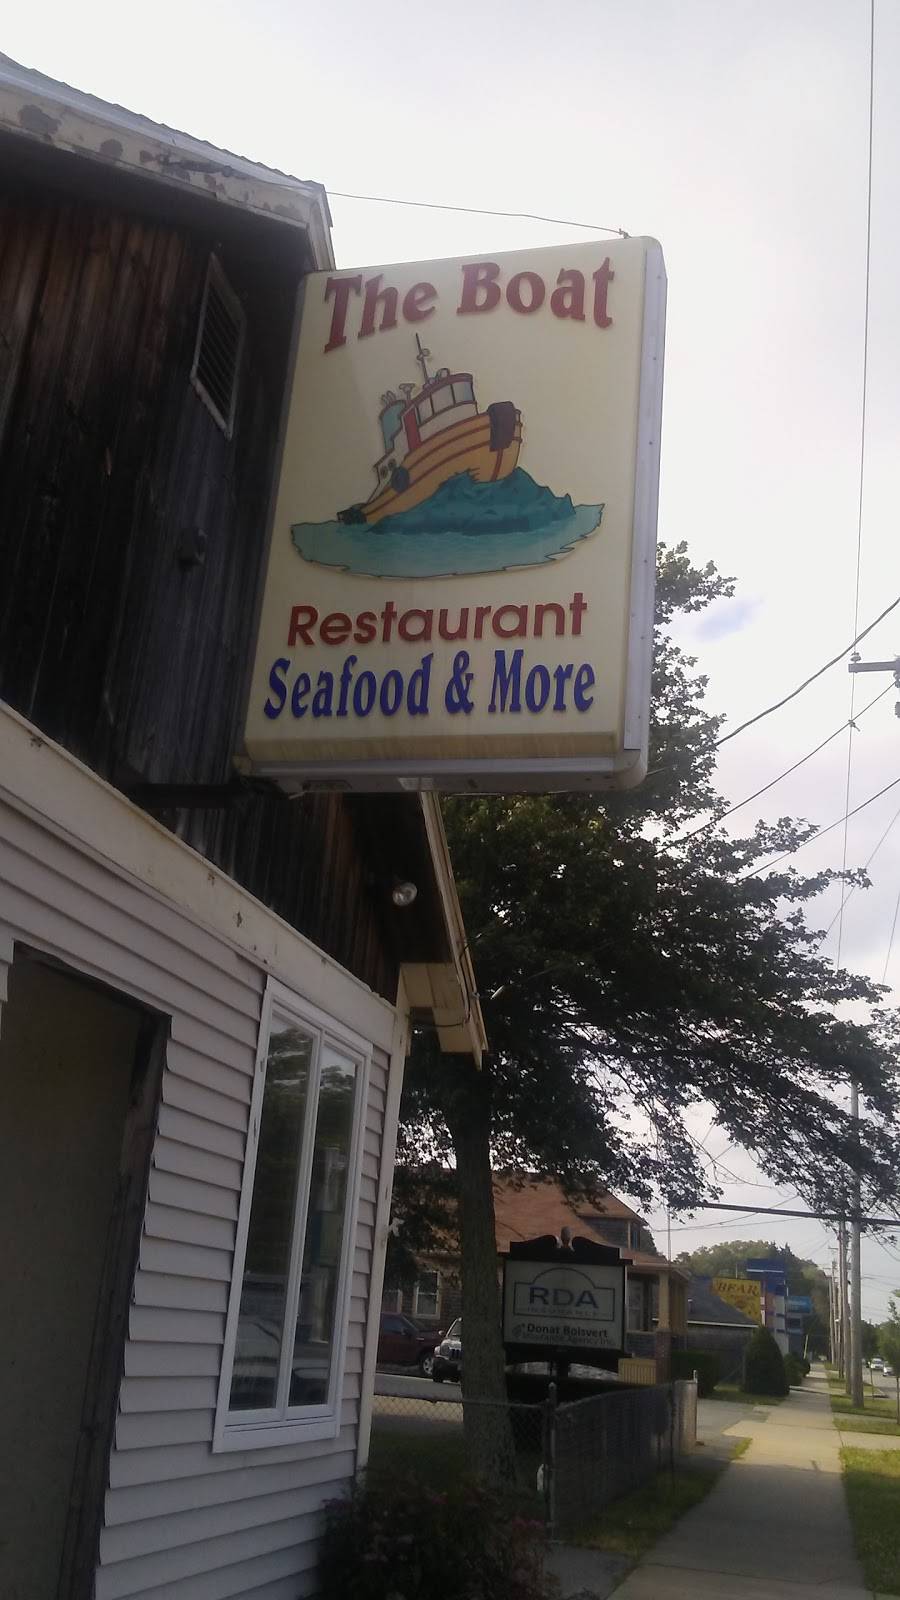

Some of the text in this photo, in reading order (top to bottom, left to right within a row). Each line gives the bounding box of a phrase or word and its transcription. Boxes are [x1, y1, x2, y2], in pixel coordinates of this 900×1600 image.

[323, 256, 616, 354] The Boat
[287, 592, 589, 647] Restaurant
[263, 648, 596, 720] Seafood & More
[528, 1286, 599, 1309] RDA
[526, 1322, 560, 1335] Donat
